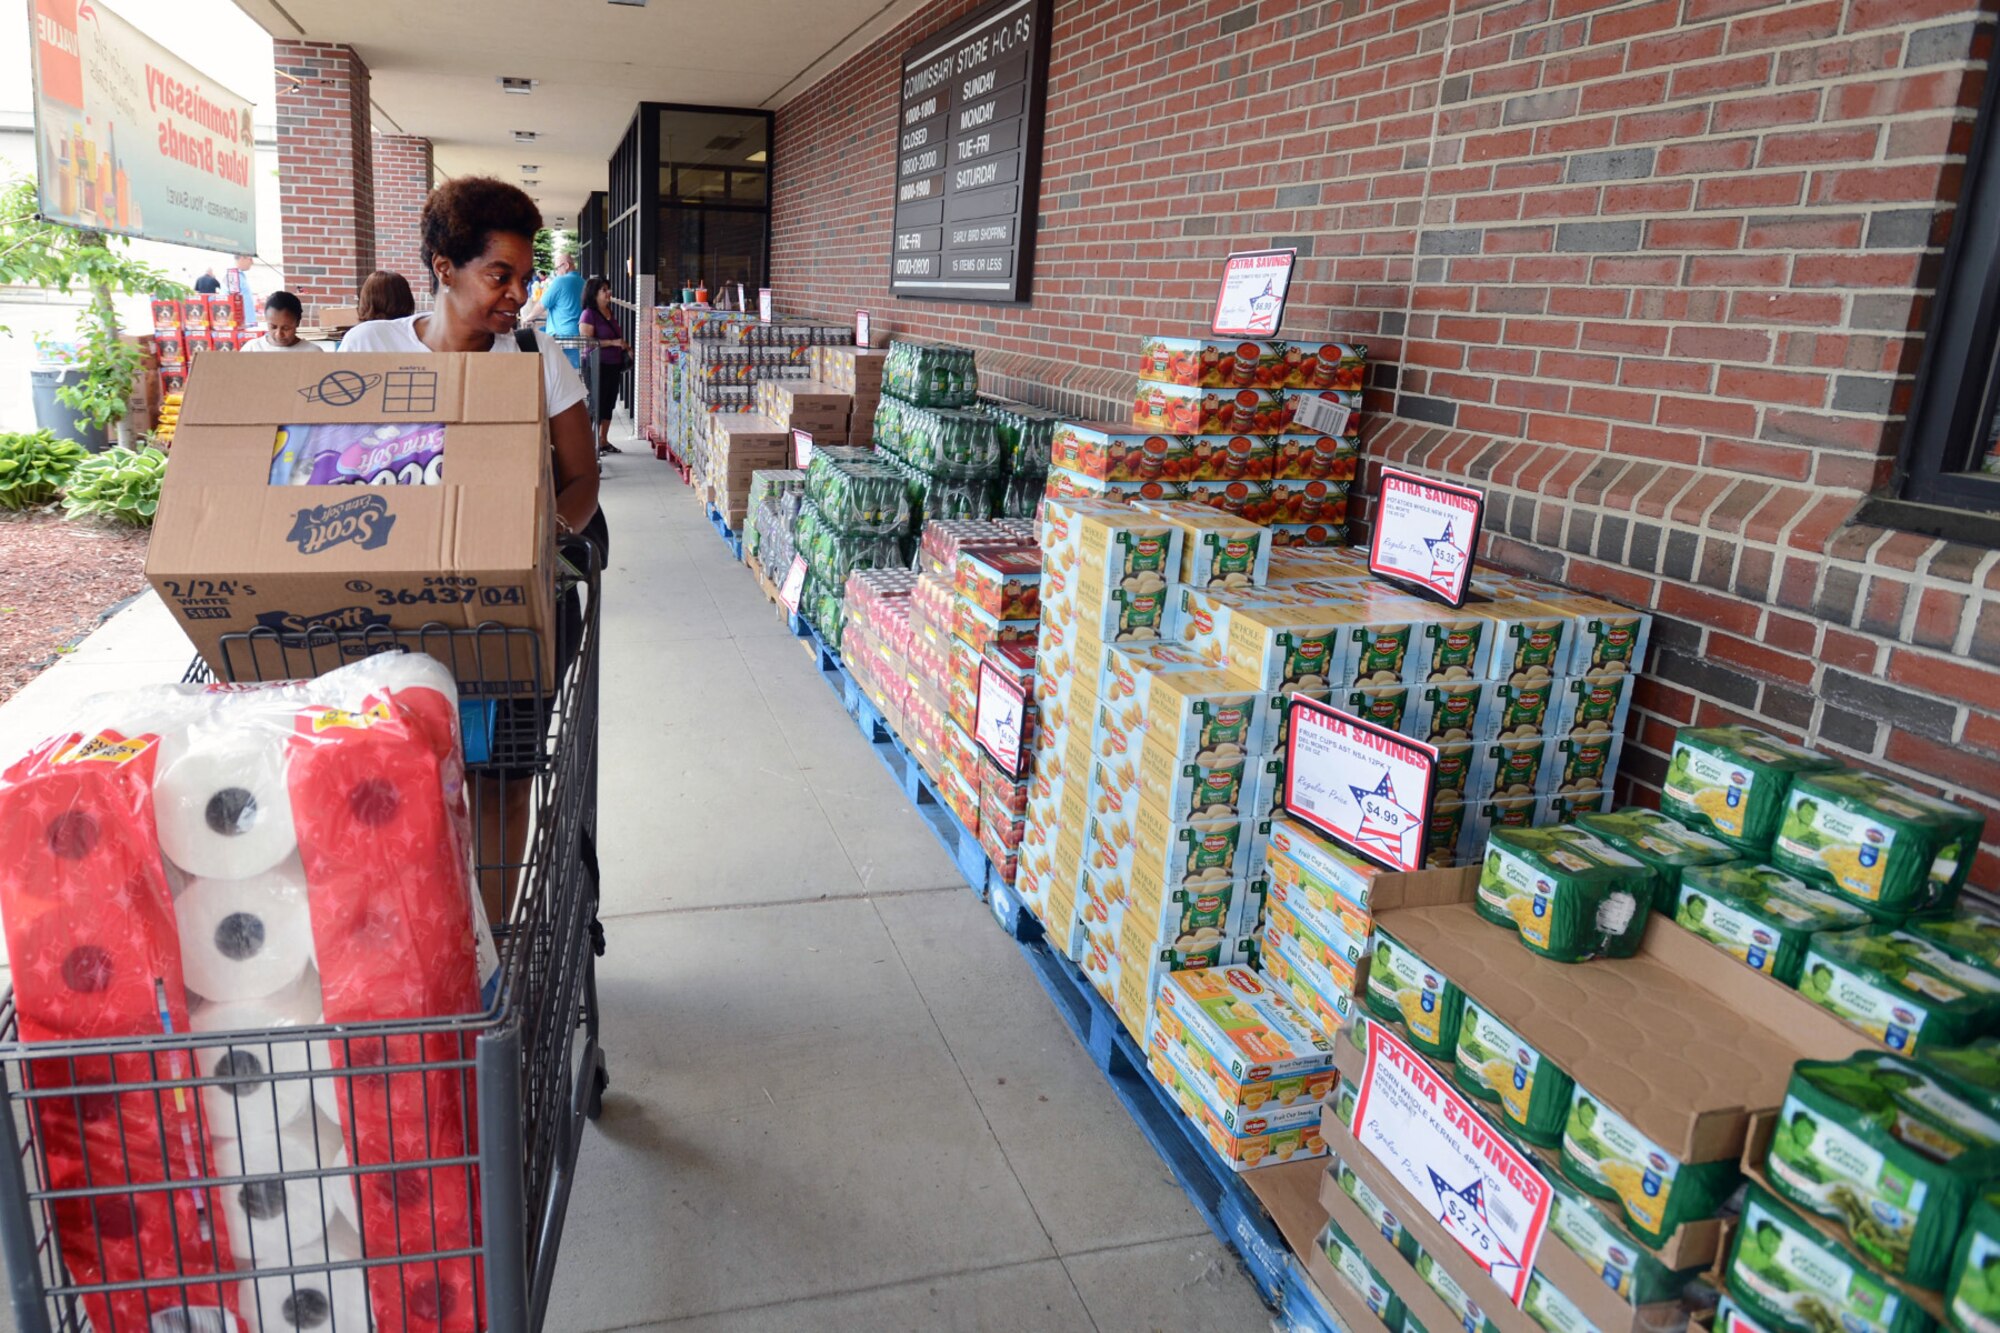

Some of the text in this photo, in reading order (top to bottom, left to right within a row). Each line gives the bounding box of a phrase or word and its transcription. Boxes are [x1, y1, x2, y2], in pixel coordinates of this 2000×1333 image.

[904, 54, 955, 99] COMMISSARY
[957, 36, 989, 74] STORE
[963, 69, 996, 100] SUNDAY
[961, 101, 996, 130] MONDAY
[902, 127, 928, 150] CLOSED
[958, 133, 990, 160] TUE-FRI
[902, 150, 937, 176] 0800-2000
[956, 162, 997, 189] SATURDAY
[899, 233, 921, 250] TUE-FRI
[960, 259, 975, 271] ITEMS
[977, 259, 986, 271] OR
[987, 258, 1003, 271] LESS
[1231, 255, 1291, 270] EXTRA SAVINGS
[403, 427, 445, 452] Extra
[358, 443, 399, 476] Soft
[1387, 477, 1476, 513] EXTRA SAVINGS
[1387, 496, 1413, 508] POTATOES
[321, 496, 372, 522] Extra Soft
[304, 509, 379, 553] Scott
[163, 579, 257, 598] 2/24's
[423, 576, 477, 586] 54000
[375, 587, 520, 605] 36437 04
[281, 606, 364, 631] Scott
[1298, 736, 1310, 745] DEL
[1310, 742, 1330, 753] MONTE
[1299, 706, 1427, 770] EXTRA SAVINGS
[1299, 728, 1318, 740] FRUIT
[1320, 735, 1338, 749] CUPS
[1338, 744, 1351, 754] AST
[1297, 775, 1348, 805] Regular Price
[1366, 801, 1399, 825] $4.99
[1376, 1072, 1398, 1097] GREEN
[1377, 1063, 1400, 1087] CORN
[1400, 1087, 1428, 1119] WHOLE
[1429, 1116, 1461, 1155] KERNEL
[1463, 1153, 1481, 1174] 4PK
[1377, 1036, 1540, 1205] EXTRA SAVINGS
[1367, 1119, 1424, 1187] Regular Price
[1448, 1200, 1491, 1251] $2.75
